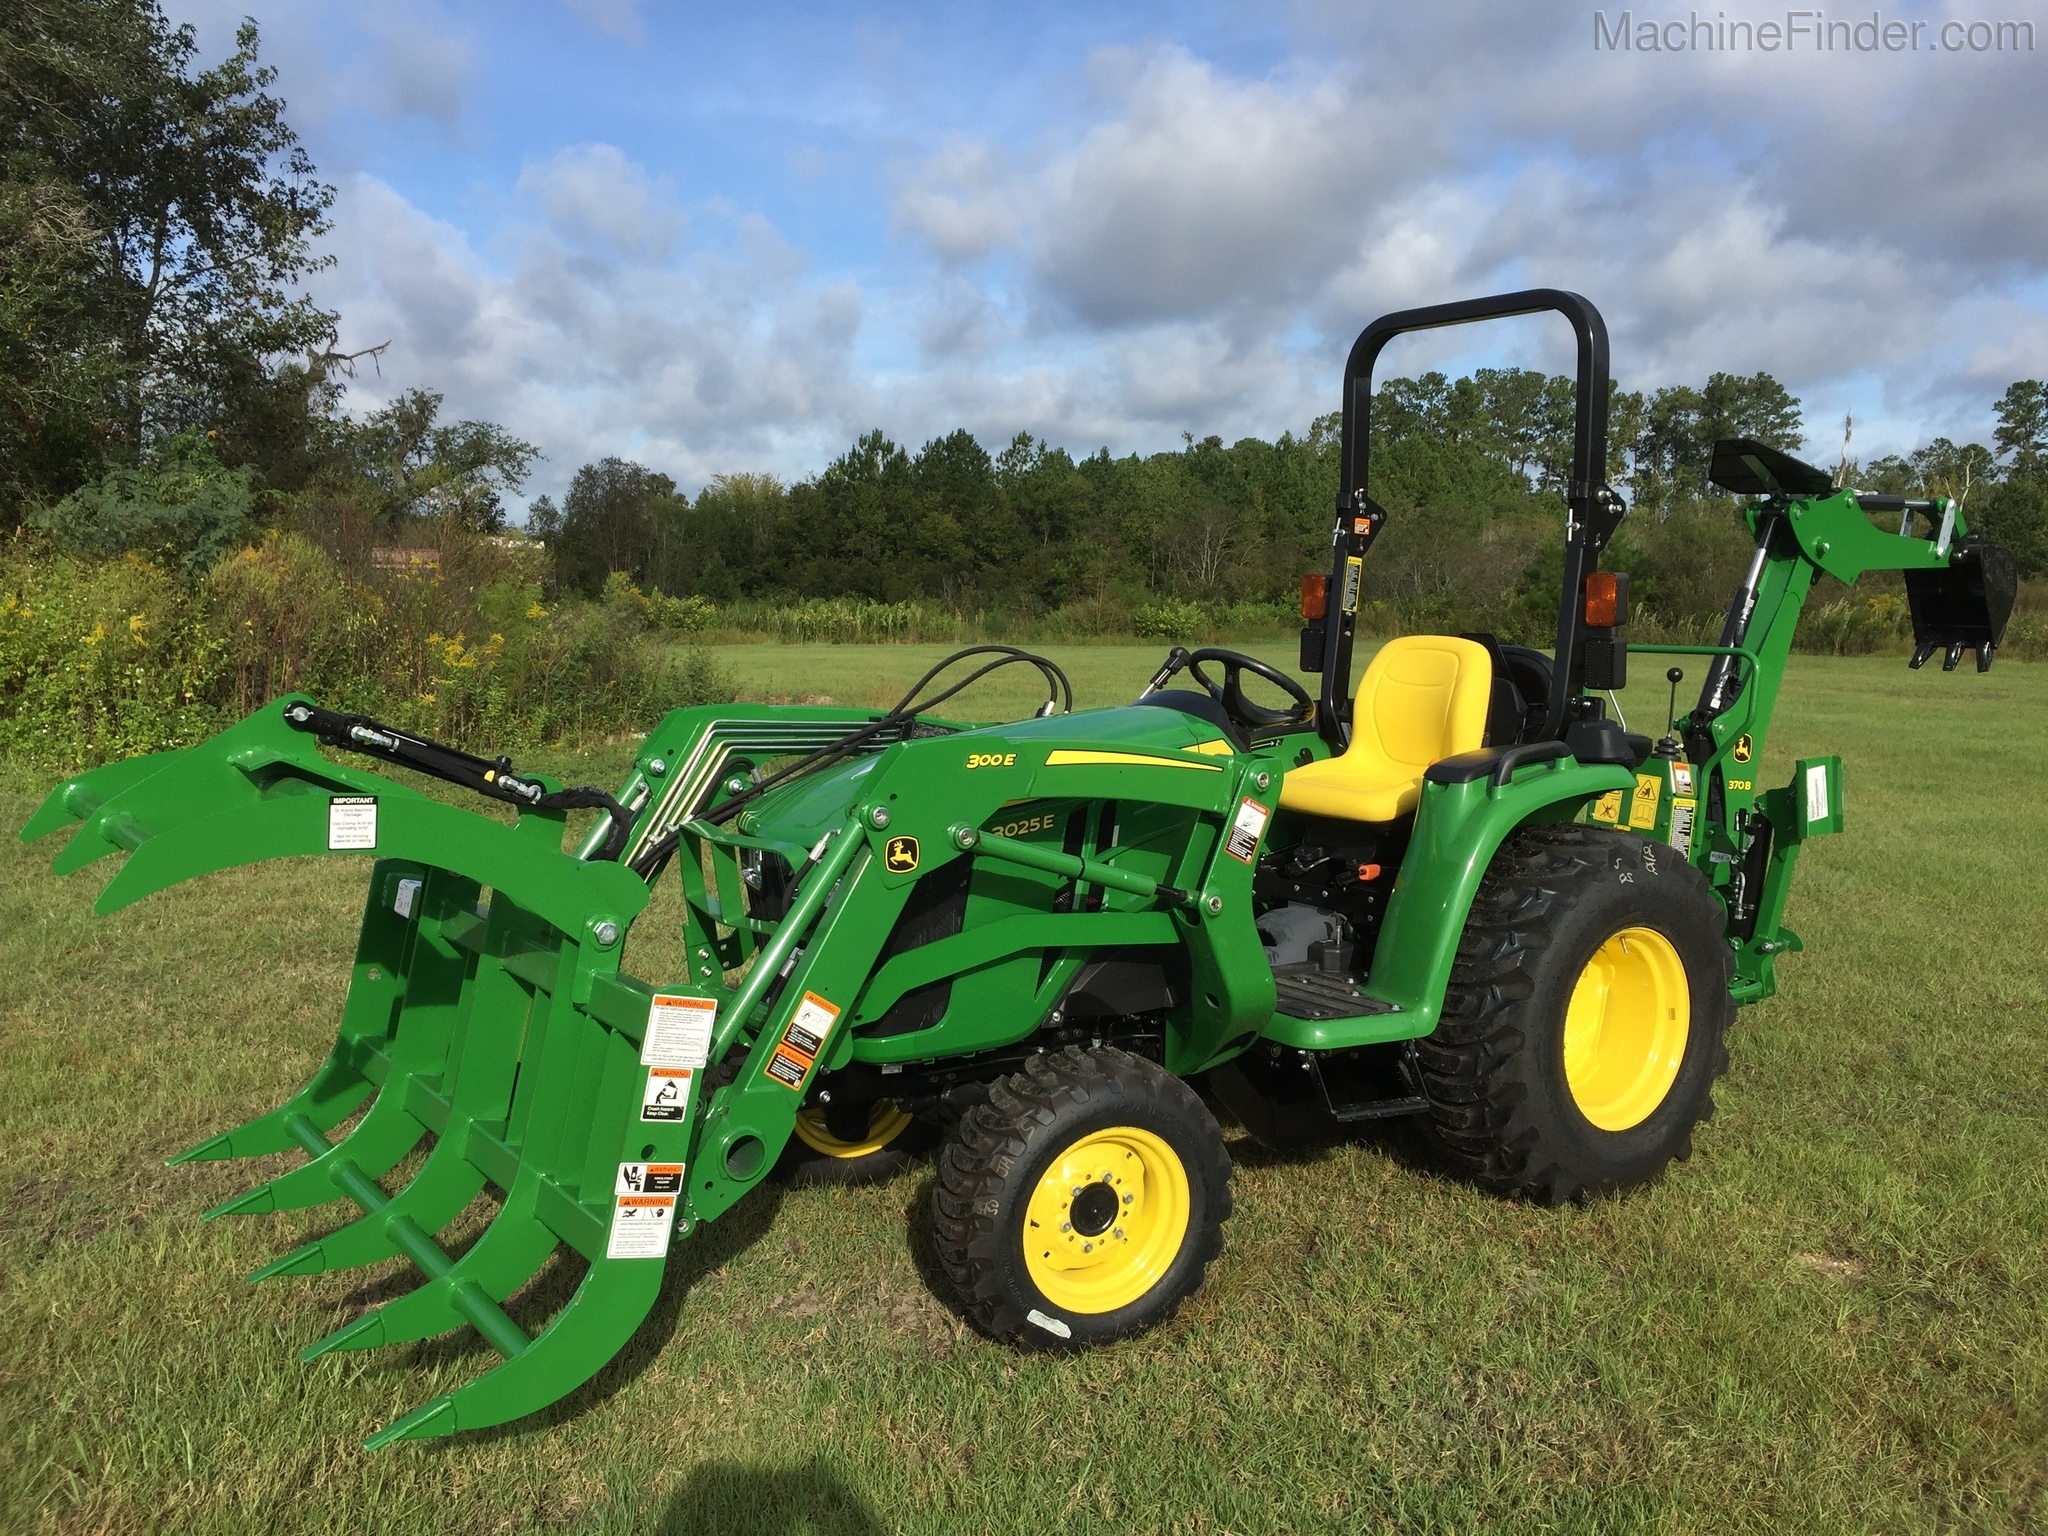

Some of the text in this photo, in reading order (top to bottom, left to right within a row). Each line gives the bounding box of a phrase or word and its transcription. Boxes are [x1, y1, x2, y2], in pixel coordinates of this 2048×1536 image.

[966, 753, 1017, 769] 300E
[1728, 780, 1752, 791] 370B
[991, 813, 1055, 838] 3025E
[672, 1000, 704, 1008] WARNING
[659, 1069, 689, 1077] WARNING
